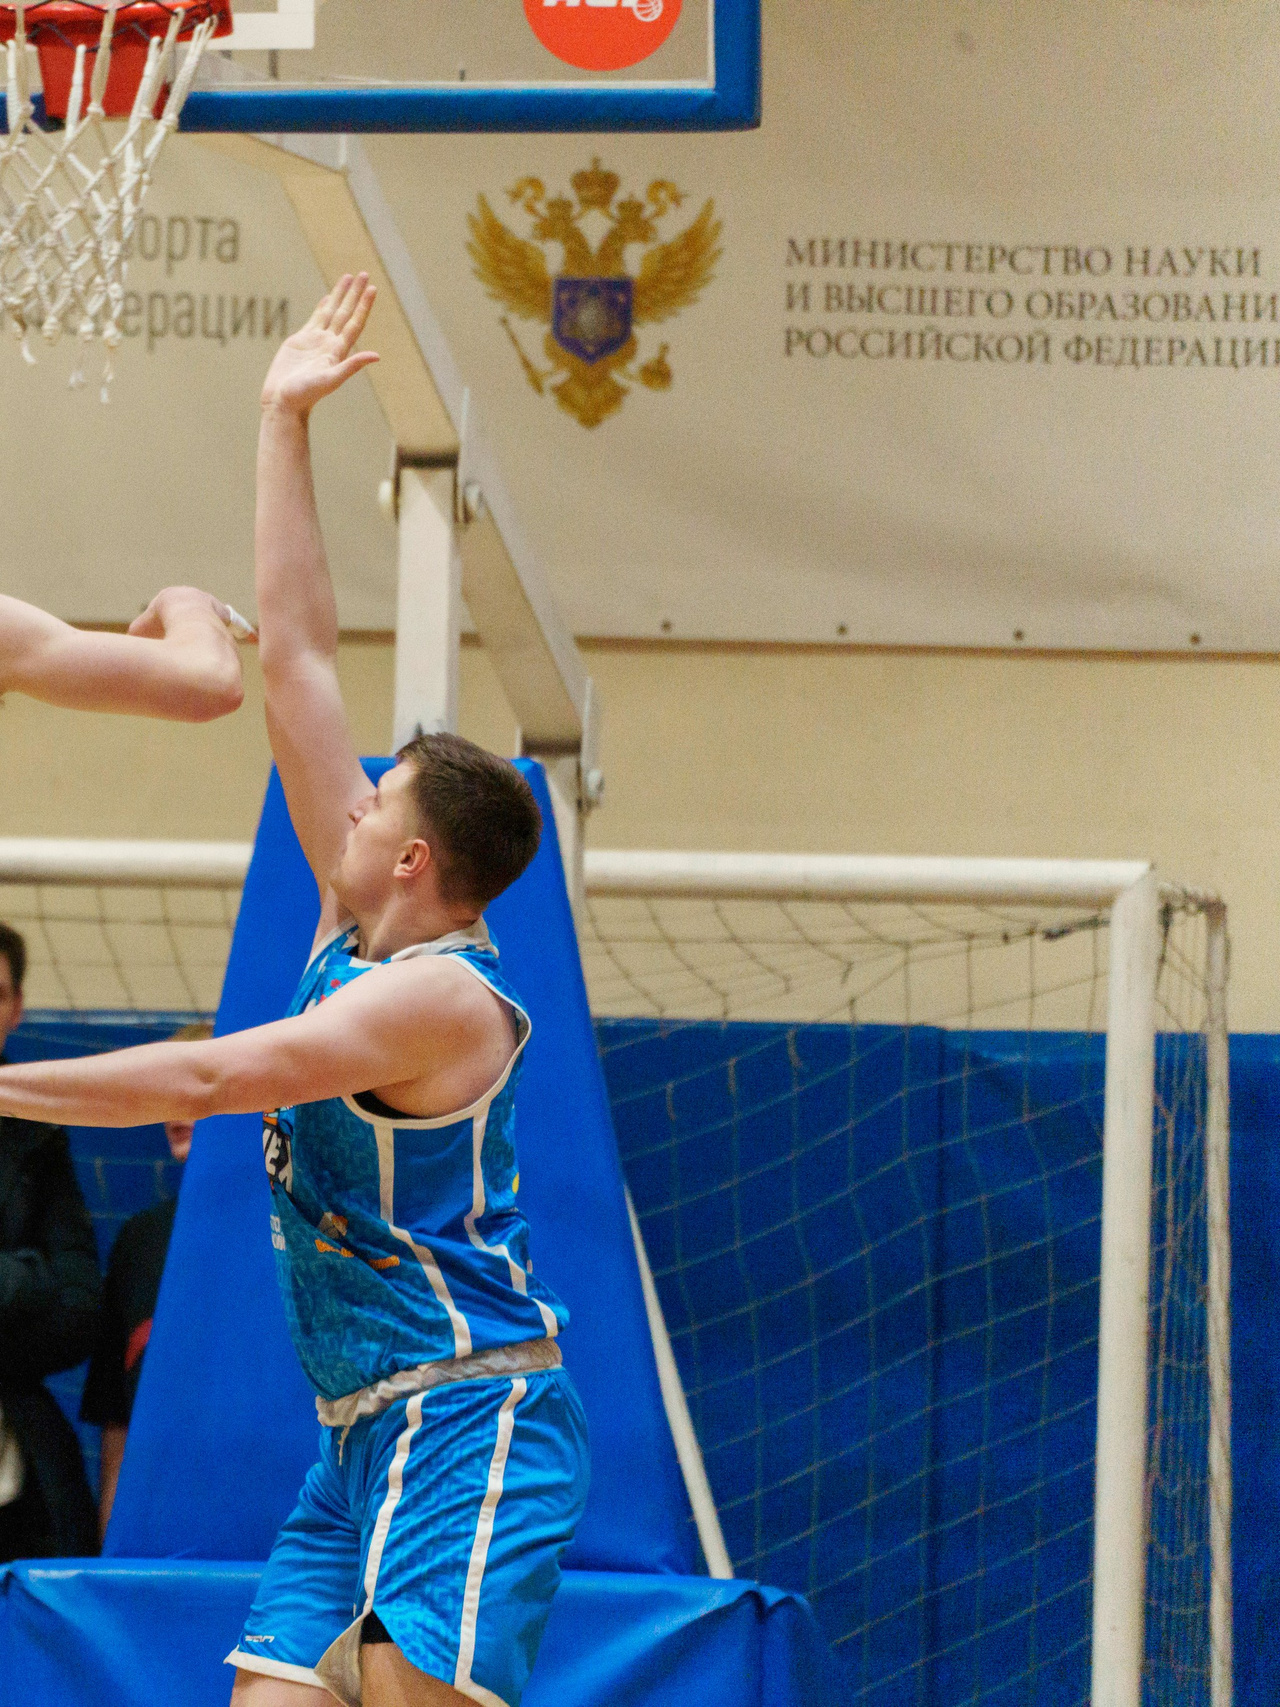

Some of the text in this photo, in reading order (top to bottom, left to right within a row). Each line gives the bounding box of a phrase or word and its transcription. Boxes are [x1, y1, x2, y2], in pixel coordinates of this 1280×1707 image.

[92, 215, 239, 276] орта
[785, 238, 1261, 277] МИНИСТЕРСТВО НАУКИ
[786, 282, 1278, 322] И ВЫСШЕГО ОБРАЗОВАНИ
[785, 325, 1051, 364] РОССИЙСКОЙ
